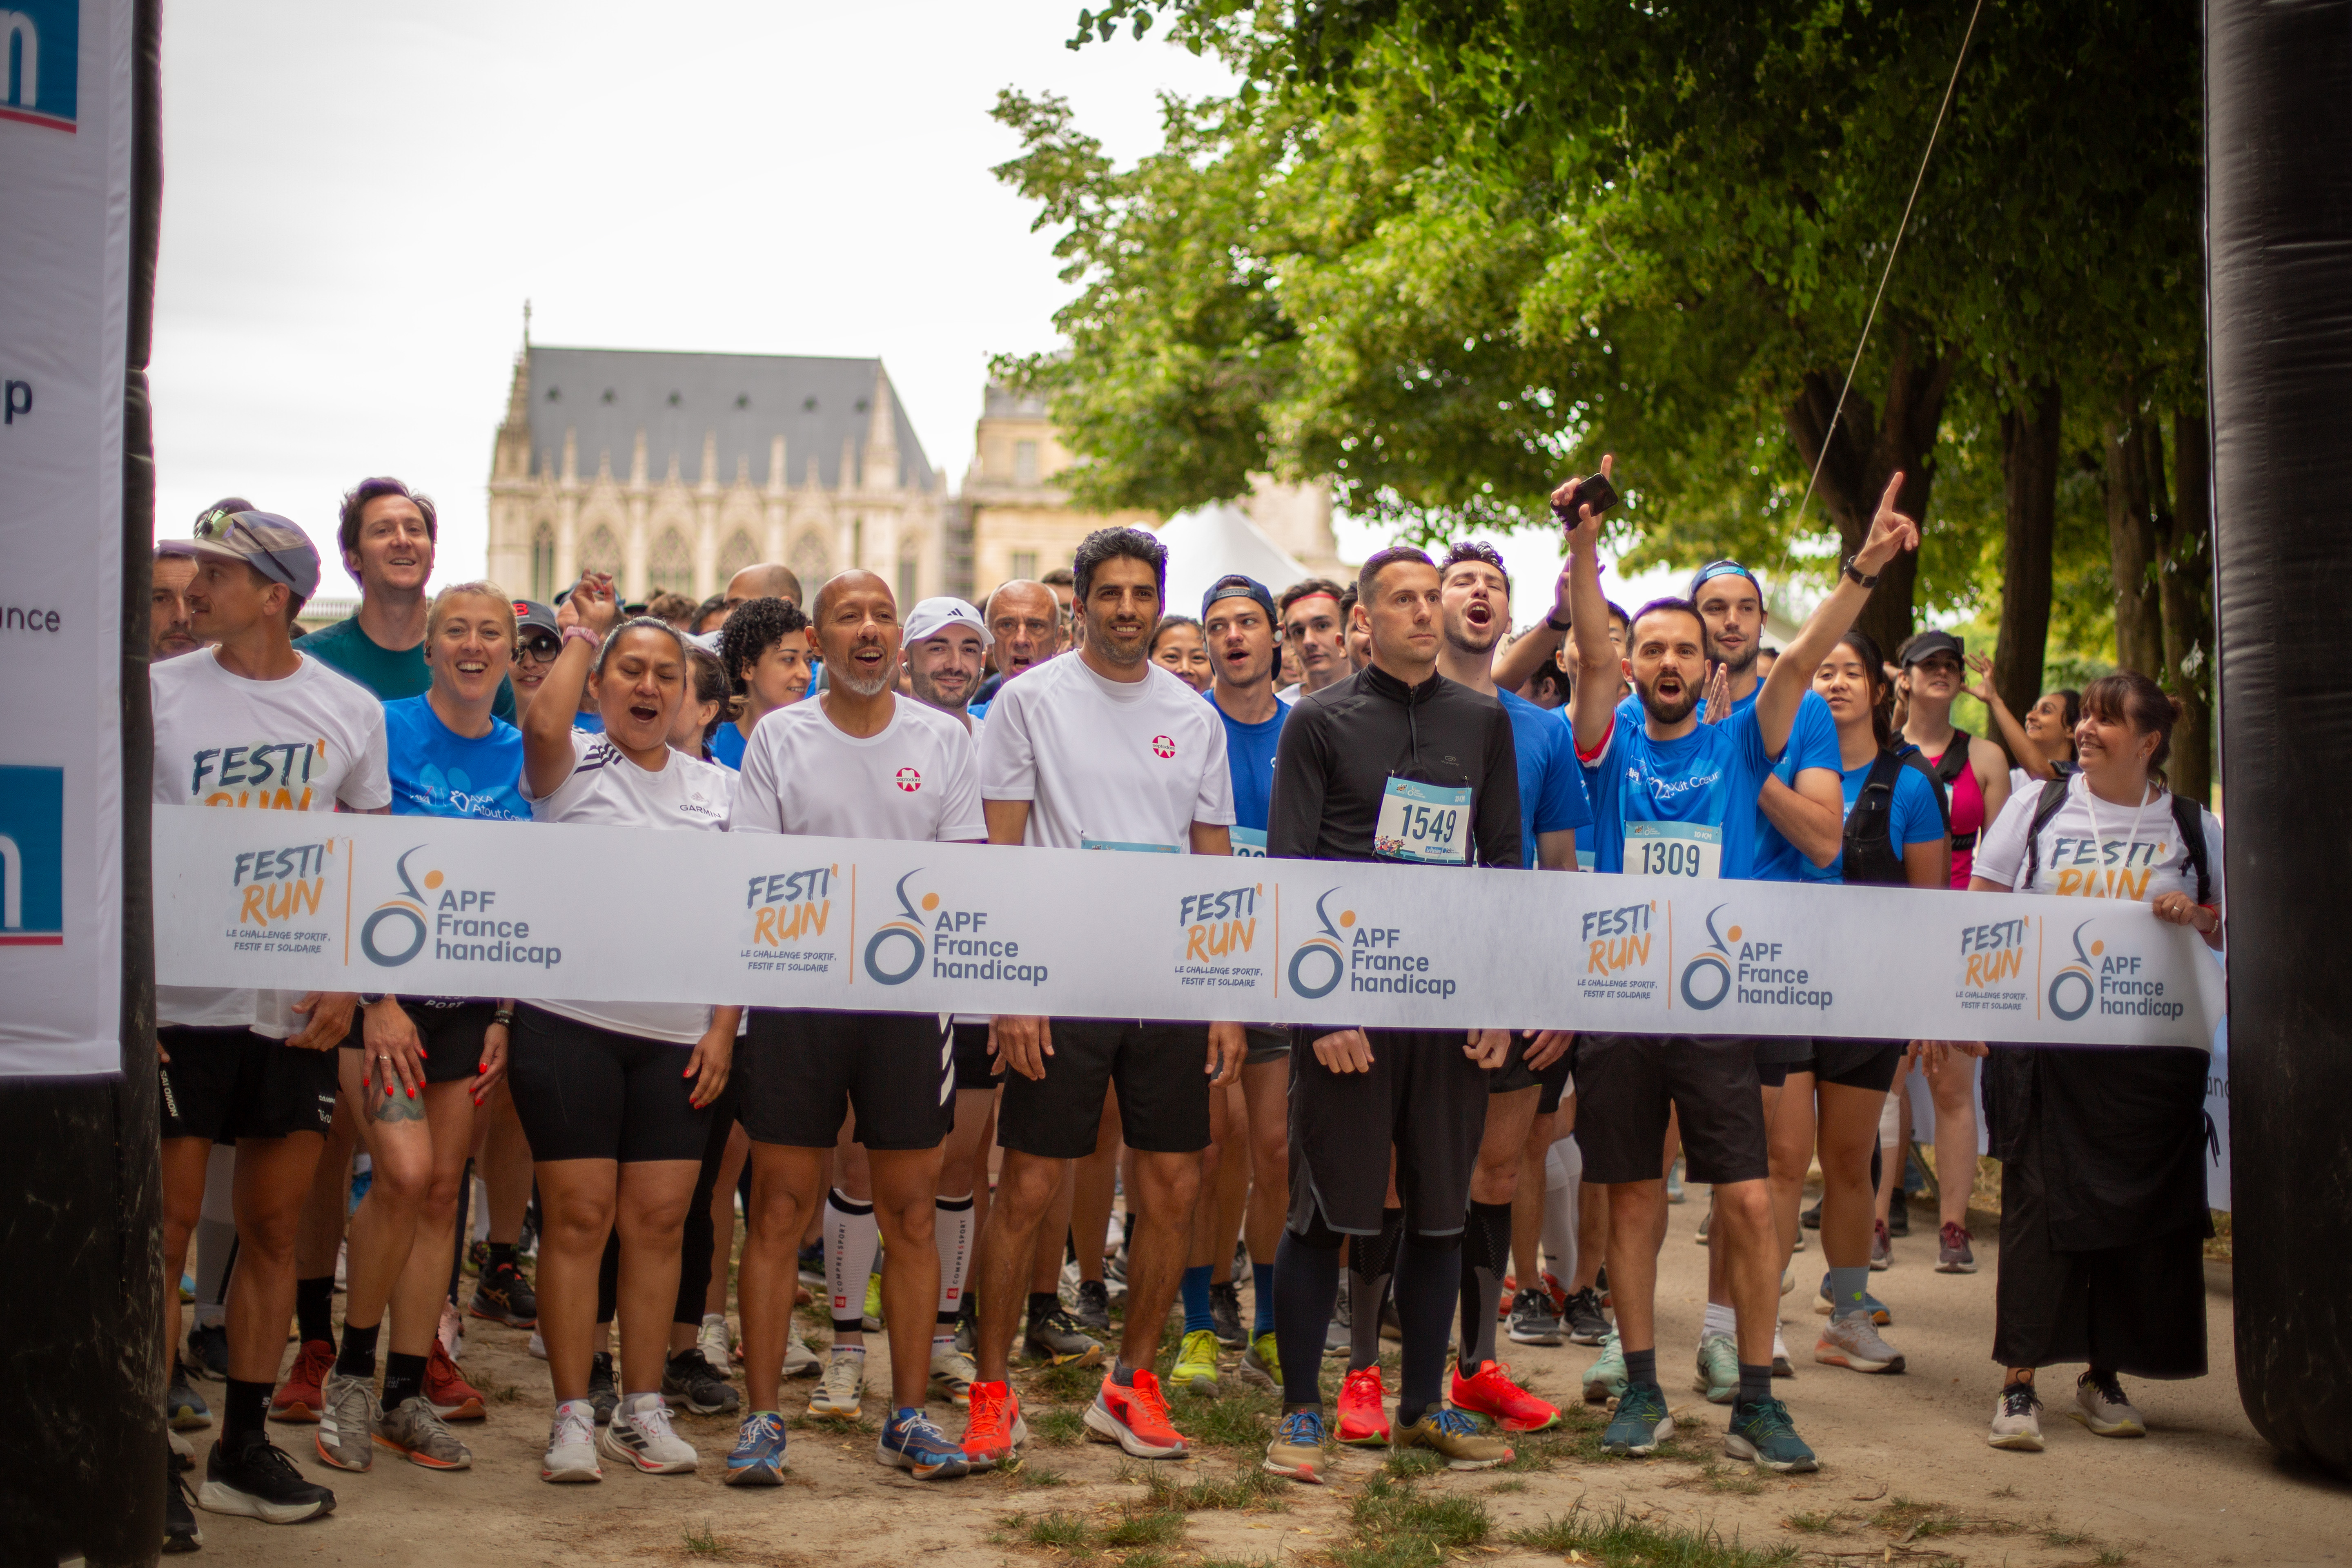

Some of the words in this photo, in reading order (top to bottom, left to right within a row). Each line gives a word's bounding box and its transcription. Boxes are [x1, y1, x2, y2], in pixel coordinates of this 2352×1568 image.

[0, 607, 60, 632] nce
[192, 737, 325, 795] FESTI'
[470, 795, 494, 803] AXA
[473, 804, 502, 819] Atout
[680, 805, 722, 818] GARMIN
[1401, 804, 1457, 843] 1549
[1702, 831, 1712, 840] KM
[234, 840, 334, 886] FESTI'
[1642, 842, 1700, 877] 1309
[2050, 838, 2166, 869] FESTI'
[747, 863, 838, 909] FESTI'
[240, 877, 324, 927] RUN
[438, 890, 495, 912] APF
[1180, 883, 1263, 927] FESTI'
[437, 914, 529, 938] France
[753, 900, 830, 947] RUN
[935, 911, 987, 933] APF
[1582, 900, 1656, 942] FESTI'
[240, 930, 291, 939] CHALLENGE
[934, 934, 1018, 958] France
[1186, 918, 1256, 963] RUN
[1352, 928, 1400, 948] APF
[1961, 915, 2029, 956] FESTI'
[234, 942, 262, 951] FESTIF
[264, 943, 275, 951] ET
[277, 944, 322, 953] SOLIDAIRE
[436, 938, 561, 969] handicap
[753, 951, 801, 959] CHALLENGE
[1588, 933, 1651, 976] RUN
[1739, 942, 1782, 962] APF
[748, 962, 774, 970] FESTIF
[788, 964, 828, 973] SOLIDAIRE
[933, 957, 1048, 987] handicap
[1186, 967, 1229, 975] CHALLENGE
[1352, 950, 1429, 972] France
[1965, 947, 2023, 989] RUN
[2101, 956, 2141, 974] APF
[1182, 977, 1205, 985] FESTIF
[1218, 979, 1255, 987] SOLIDAIRE
[1588, 980, 1628, 988] CHALLENGE
[1738, 963, 1808, 984] France
[1351, 972, 1456, 1000] handicap
[1617, 991, 1650, 999] SOLIDAIRE
[1738, 984, 1833, 1011] handicap
[2100, 976, 2164, 996] France
[2100, 997, 2184, 1021] handicap
